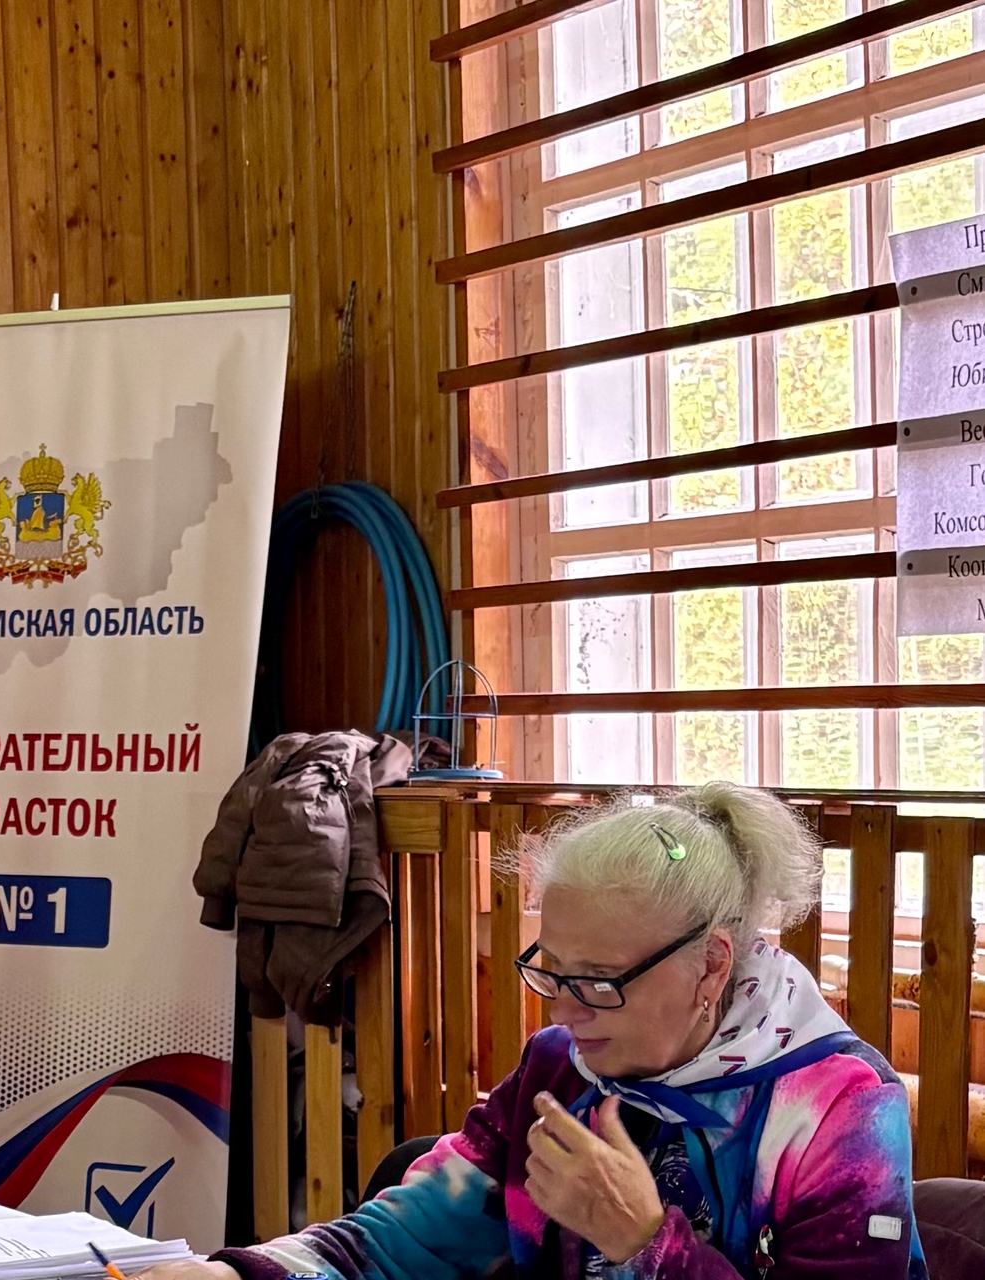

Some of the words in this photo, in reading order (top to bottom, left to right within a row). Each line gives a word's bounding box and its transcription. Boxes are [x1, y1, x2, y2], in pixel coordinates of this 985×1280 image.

[957, 272, 985, 297] См
[951, 318, 985, 347] Стр
[960, 419, 985, 443] Ве
[84, 606, 205, 637] ОБЛАСТЬ
[46, 886, 68, 935] 1
